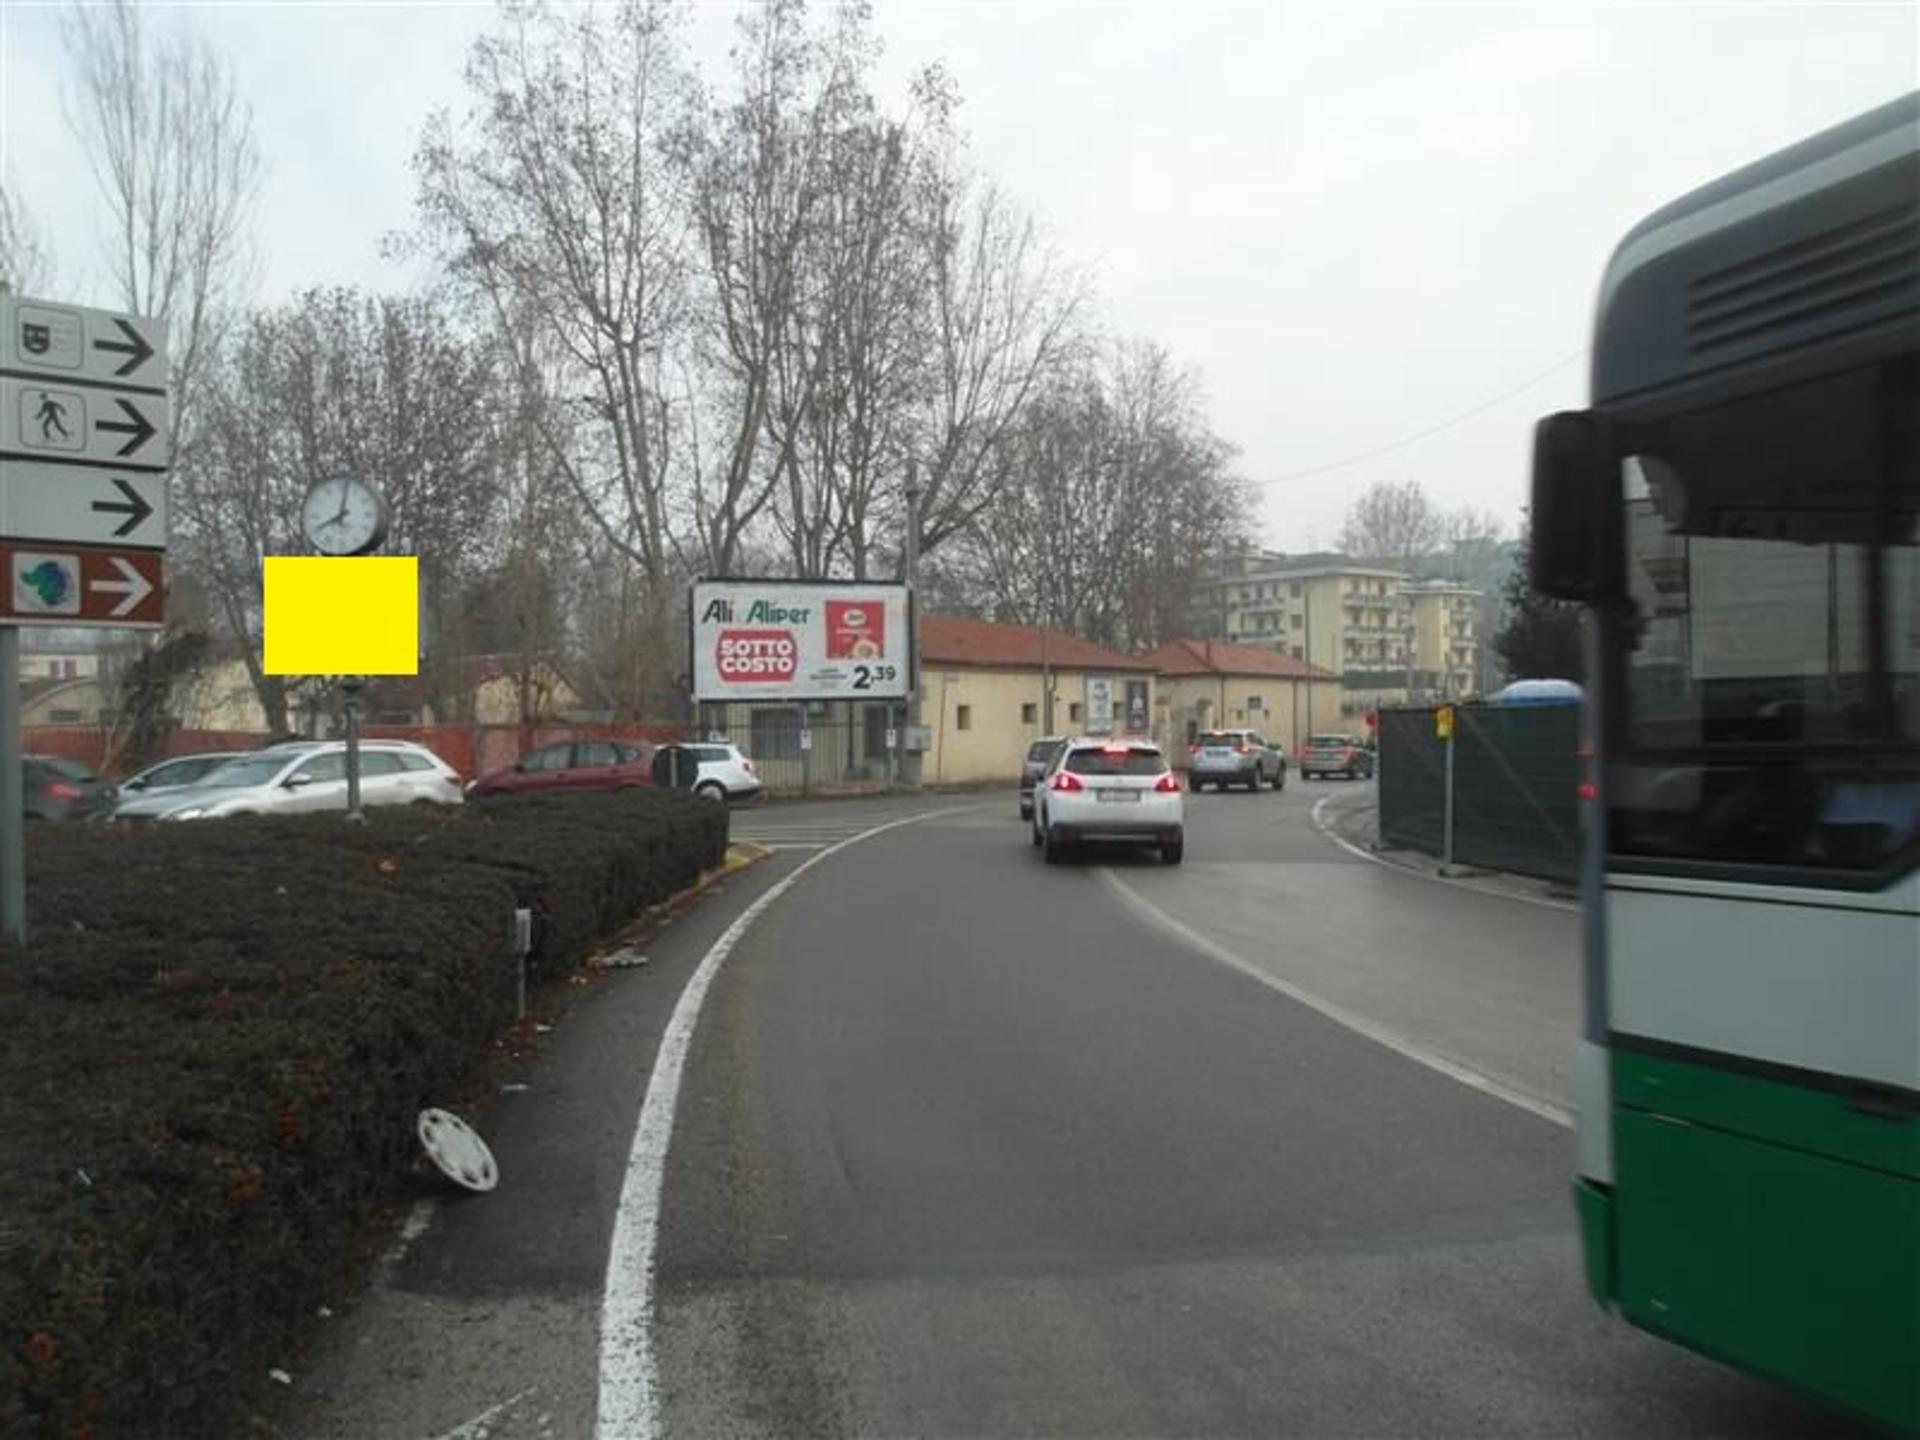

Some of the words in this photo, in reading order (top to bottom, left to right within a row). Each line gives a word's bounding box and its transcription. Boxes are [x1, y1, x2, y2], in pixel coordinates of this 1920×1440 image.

[746, 599, 811, 624] Aliper
[720, 639, 793, 656] SOTTO
[720, 657, 793, 673] COSTO
